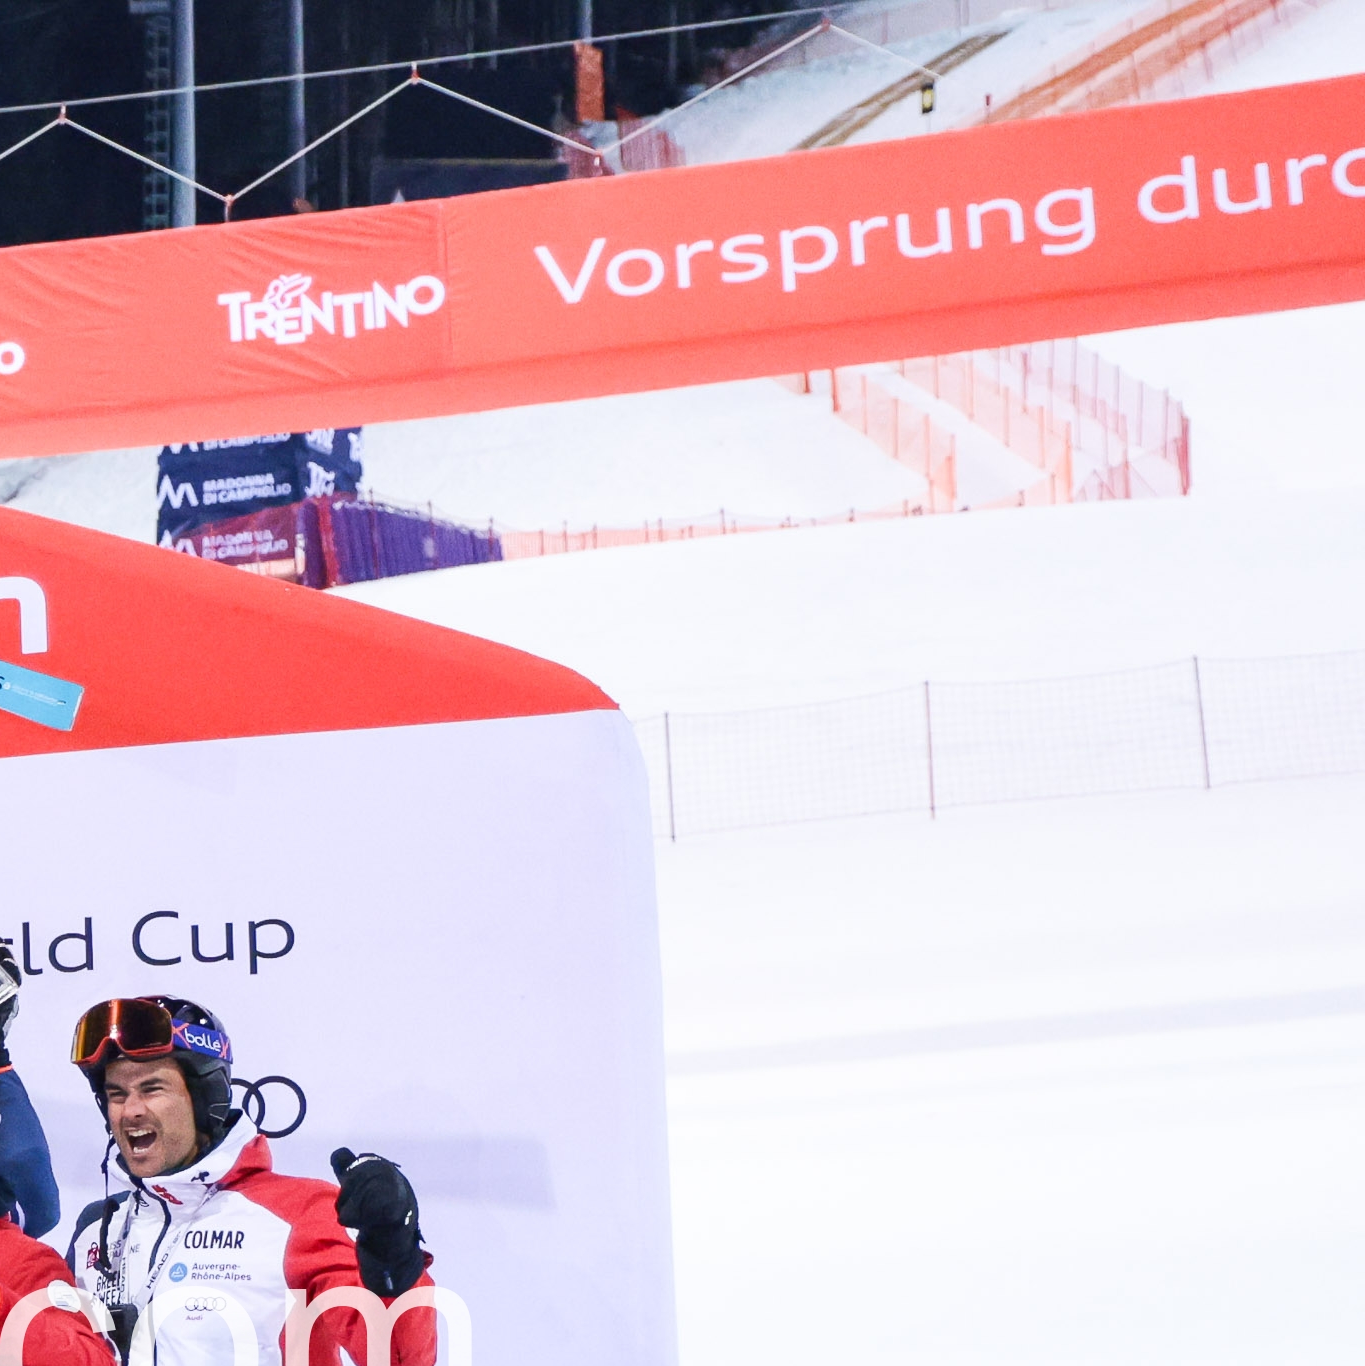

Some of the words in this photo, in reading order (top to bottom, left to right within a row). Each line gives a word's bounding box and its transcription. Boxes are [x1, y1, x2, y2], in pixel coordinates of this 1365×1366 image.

[534, 186, 1095, 305] Vorsprung
[217, 273, 446, 346] TRENTINO
[203, 473, 275, 492] MADONNA
[219, 483, 292, 502] CAMPIGLIO
[132, 910, 292, 975] Cup
[184, 1029, 221, 1053] bollé
[184, 1230, 245, 1250] COLMAR
[146, 1251, 170, 1290] HEAD
[191, 1271, 252, 1283] Rhône-Alpes
[192, 1262, 242, 1273] Auvergne-
